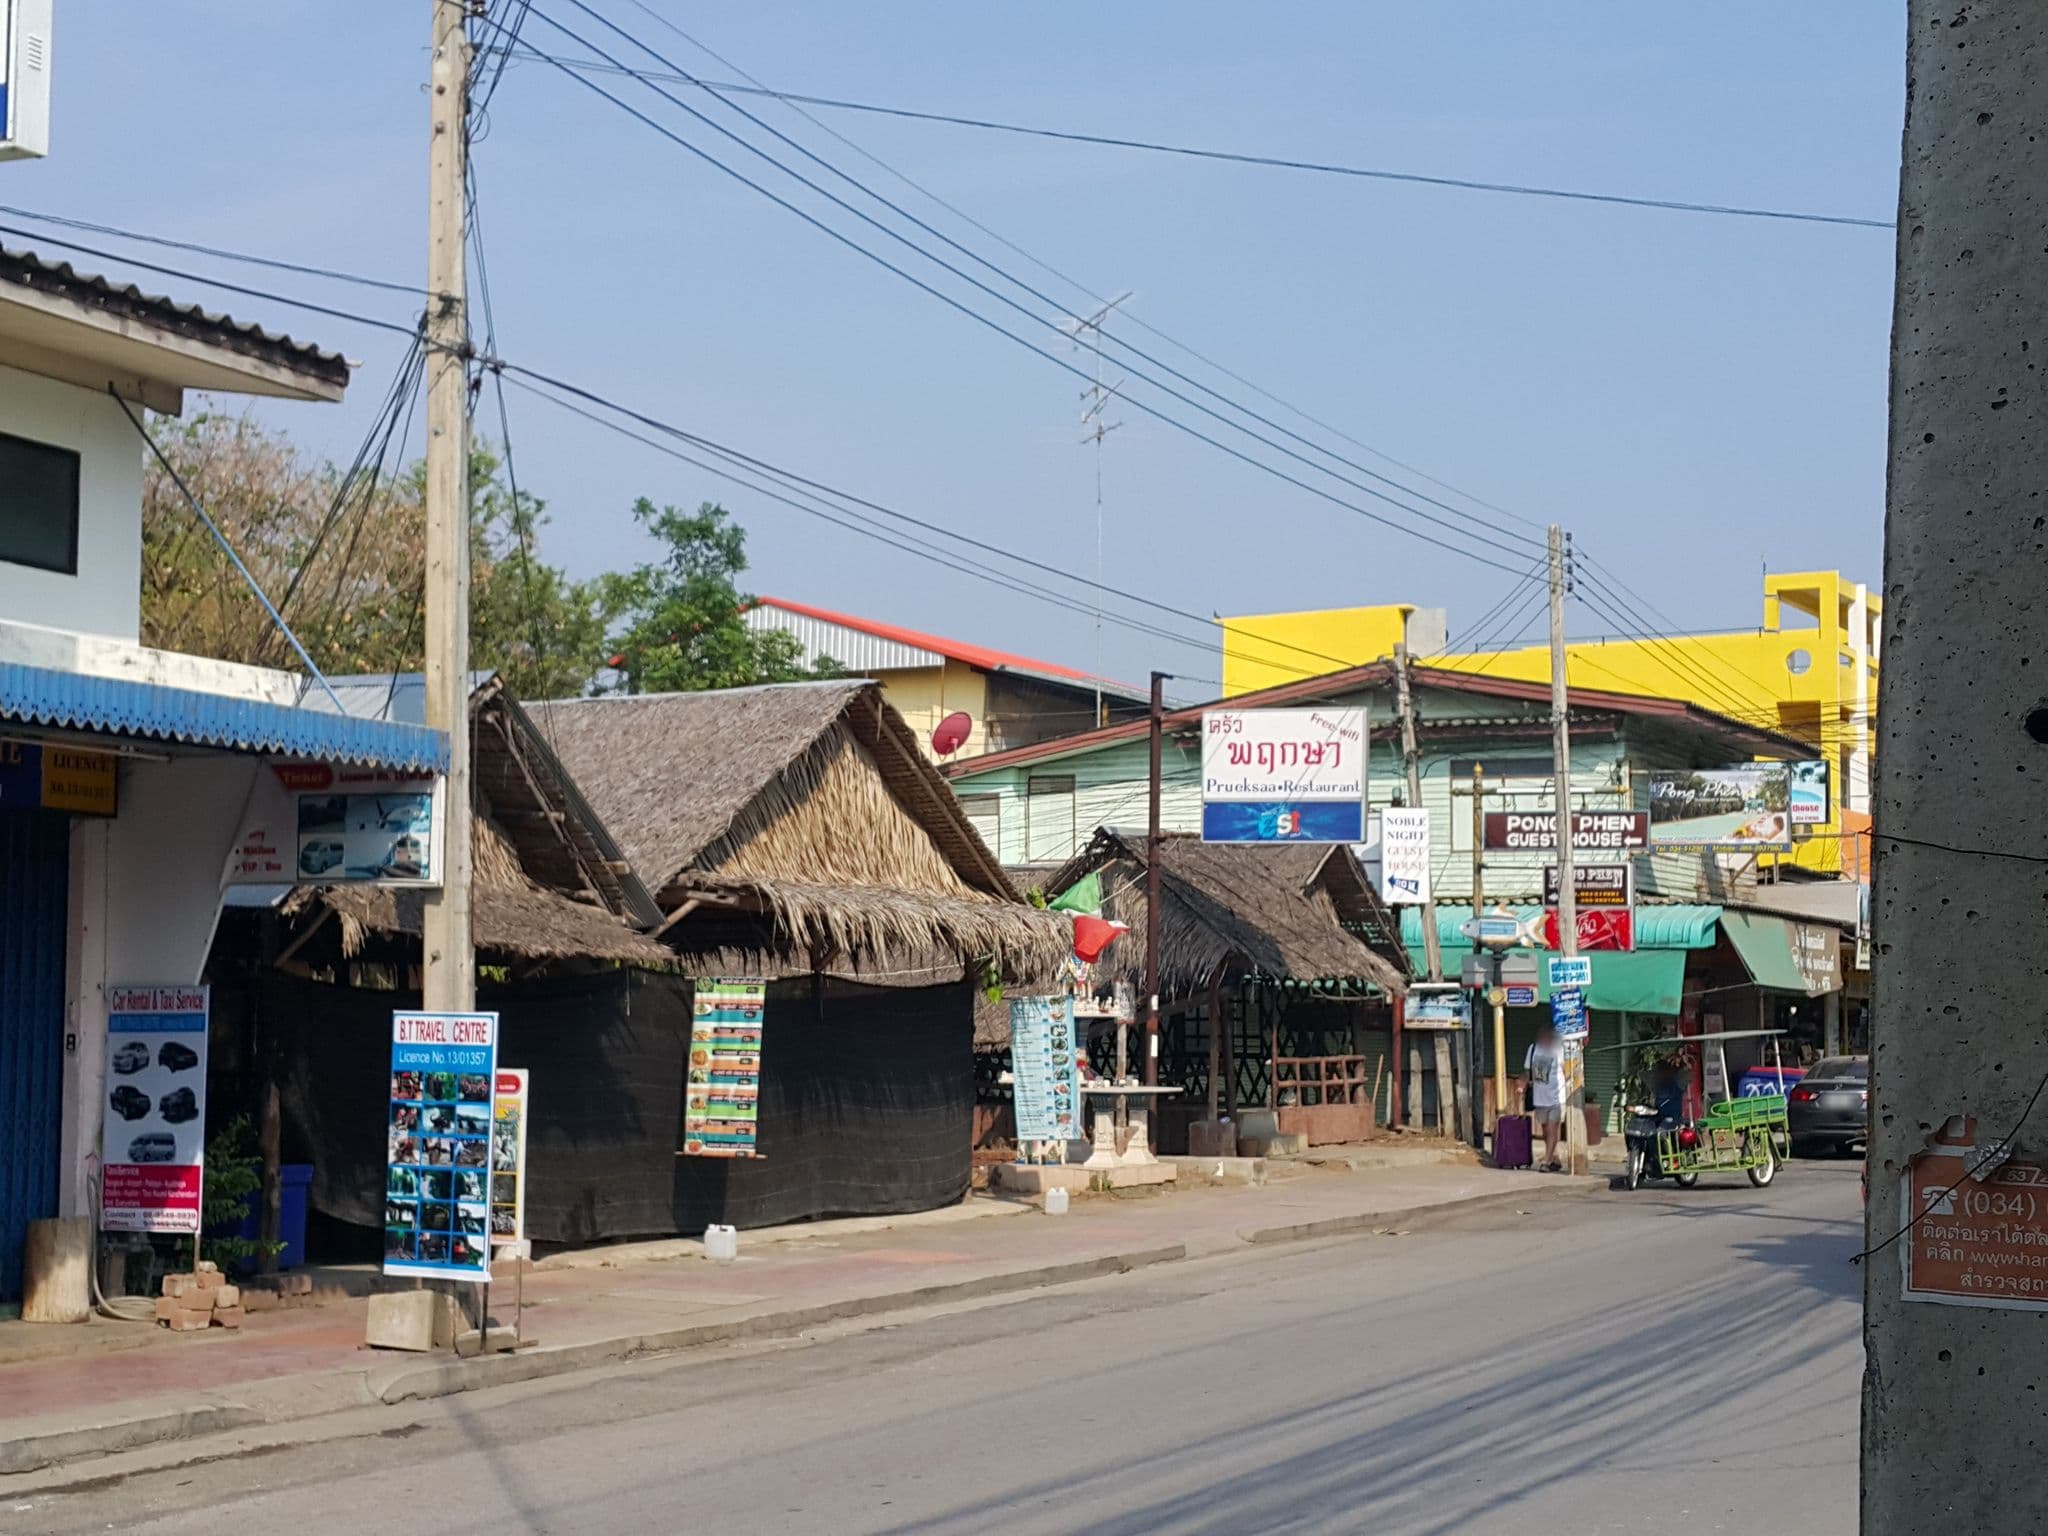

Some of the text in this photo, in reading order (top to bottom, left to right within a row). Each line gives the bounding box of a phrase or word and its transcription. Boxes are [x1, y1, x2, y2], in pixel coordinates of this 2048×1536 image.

[1209, 713, 1243, 734] ครัว
[1310, 712, 1337, 732] Free
[1227, 740, 1342, 775] พฤกษา
[1659, 779, 1745, 804] Pong Phen
[1387, 816, 1427, 827] NOBLE
[1579, 815, 1636, 831] PHEN
[1387, 831, 1426, 841] NIGHT
[1387, 847, 1426, 856] GUEST
[113, 989, 127, 1011] Car
[176, 989, 204, 1010] Service
[400, 1020, 487, 1043] B.T TRAVEL CENTRE
[399, 1051, 430, 1063] Licence
[1964, 1189, 2036, 1221] (034)
[1960, 1266, 2048, 1292] สำรวจสถ
